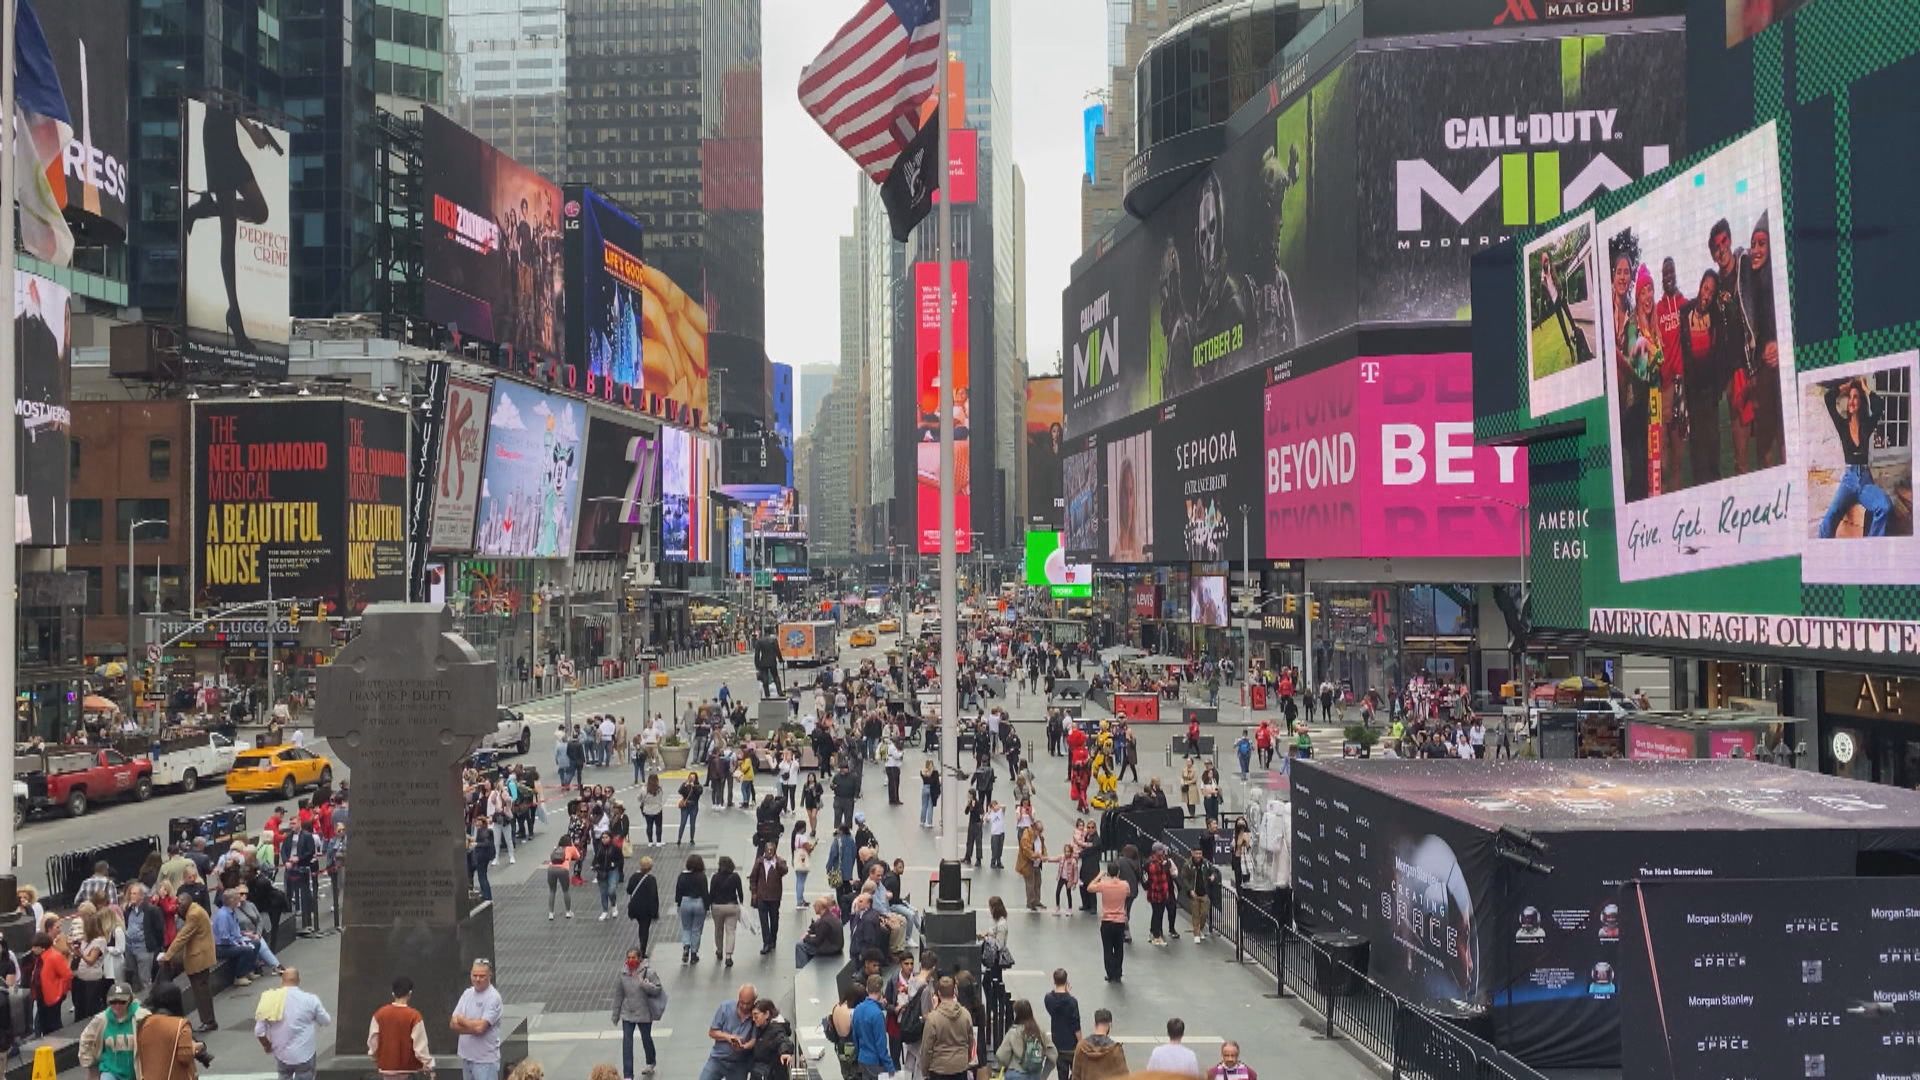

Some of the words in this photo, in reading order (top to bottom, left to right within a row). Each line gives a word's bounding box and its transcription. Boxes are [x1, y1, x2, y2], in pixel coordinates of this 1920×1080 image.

[1548, 0, 1631, 15] MARQUIS
[1444, 115, 1521, 149] CALL
[1530, 108, 1617, 144] DUTY
[239, 225, 288, 250] PERFECT
[566, 221, 579, 229] LG
[254, 246, 288, 267] CRIME
[1193, 330, 1230, 368] OCTOBER
[1232, 324, 1243, 351] 28
[506, 345, 576, 388] 1540
[586, 371, 702, 428] BROADWAY
[209, 416, 238, 443] THE
[349, 417, 365, 447] THE
[208, 443, 245, 471] NEIL
[248, 441, 328, 471] DIAMOND
[349, 446, 368, 473] NEIL
[368, 448, 406, 477] DIAMOND
[1176, 430, 1237, 471] SEPHORA
[1268, 432, 1356, 495] BEYOND
[208, 471, 274, 501] MUSICAL
[349, 473, 381, 501] MUSICAL
[207, 504, 219, 543] A
[223, 502, 322, 543] BEAUTIFUL
[349, 502, 355, 541] A
[357, 504, 404, 541] BEAUTIFUL
[1628, 519, 1662, 561] Give.
[1719, 482, 1791, 544] Repeat!
[206, 544, 260, 584] NOISE
[349, 542, 375, 579] NOISE
[219, 622, 300, 633] LUGGAGE
[1264, 616, 1294, 630] SEPHORA
[1590, 610, 1691, 639] AMERICAN
[1698, 614, 1770, 644] EAGLE
[1776, 617, 1920, 653] OUTFITTE
[349, 690, 397, 701] FRANCIS
[412, 689, 452, 701] DUFFY
[1857, 673, 1901, 715] AE
[1395, 856, 1417, 877] Morgan
[1673, 868, 1713, 876] Generation
[1391, 880, 1445, 917] CREATING
[1381, 890, 1458, 957] SPACE
[1687, 913, 1720, 925] Morgan
[1721, 911, 1753, 924] Stanley
[1785, 922, 1839, 933] SPACE
[1871, 908, 1905, 921] Morgan
[1694, 957, 1746, 967] SPACE
[1688, 995, 1720, 1007] Morgan
[1721, 994, 1754, 1006] Stanley
[1873, 990, 1908, 1003] Morgan
[1787, 1016, 1840, 1027] SPACE
[1697, 1040, 1749, 1051] SPACE
